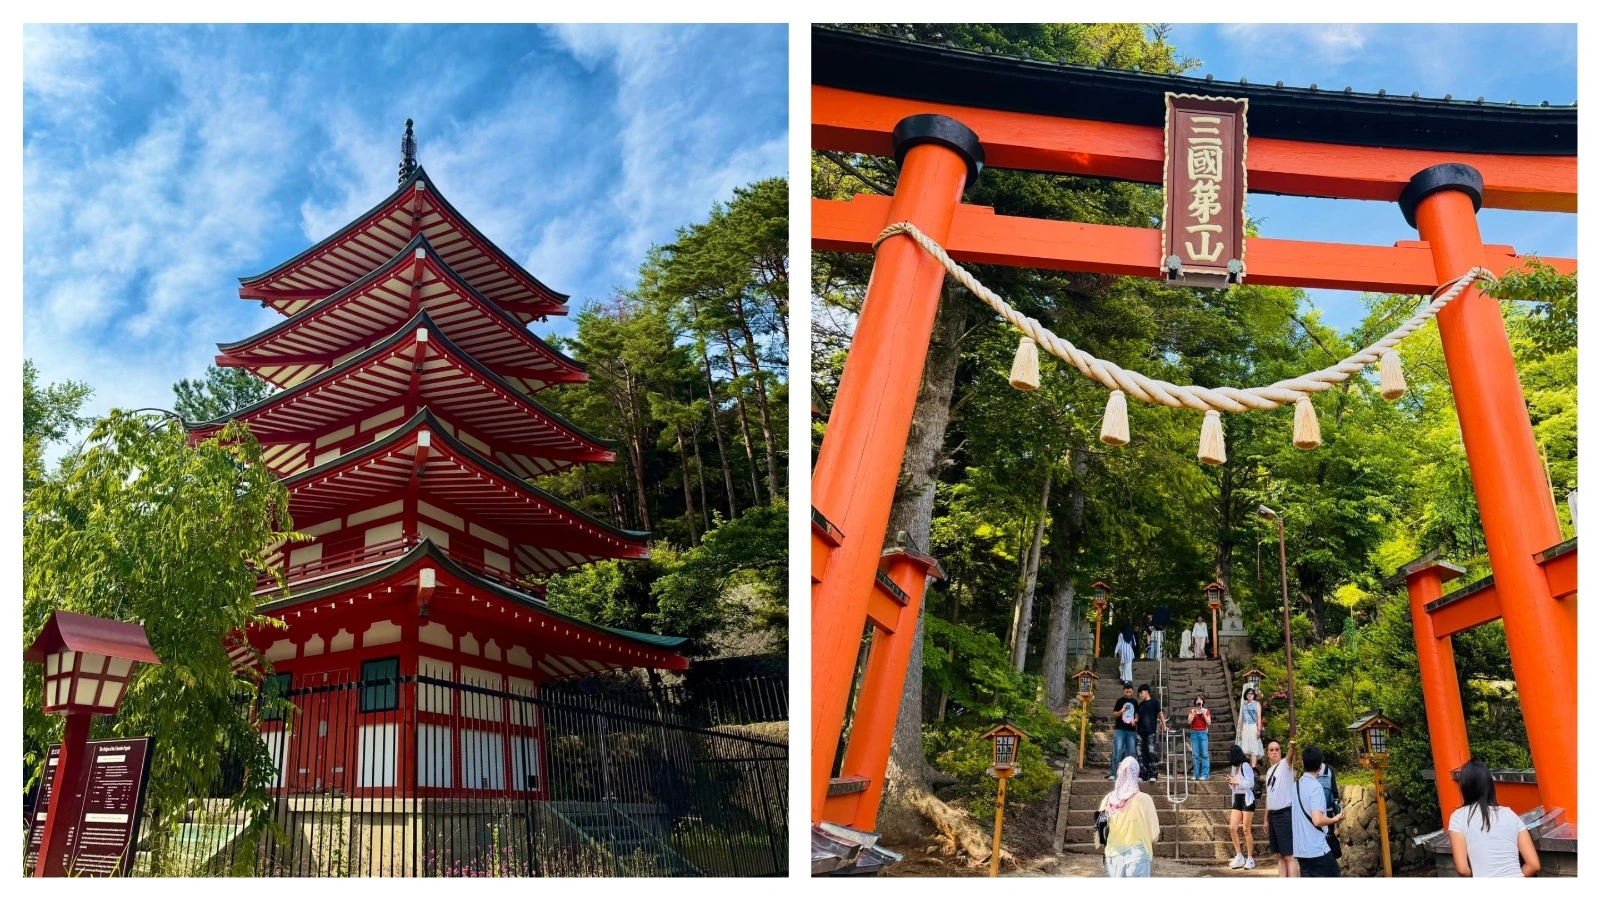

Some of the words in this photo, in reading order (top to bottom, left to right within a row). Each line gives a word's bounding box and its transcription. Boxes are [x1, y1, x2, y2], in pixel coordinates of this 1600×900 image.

[1184, 115, 1225, 263] 三國第一山
